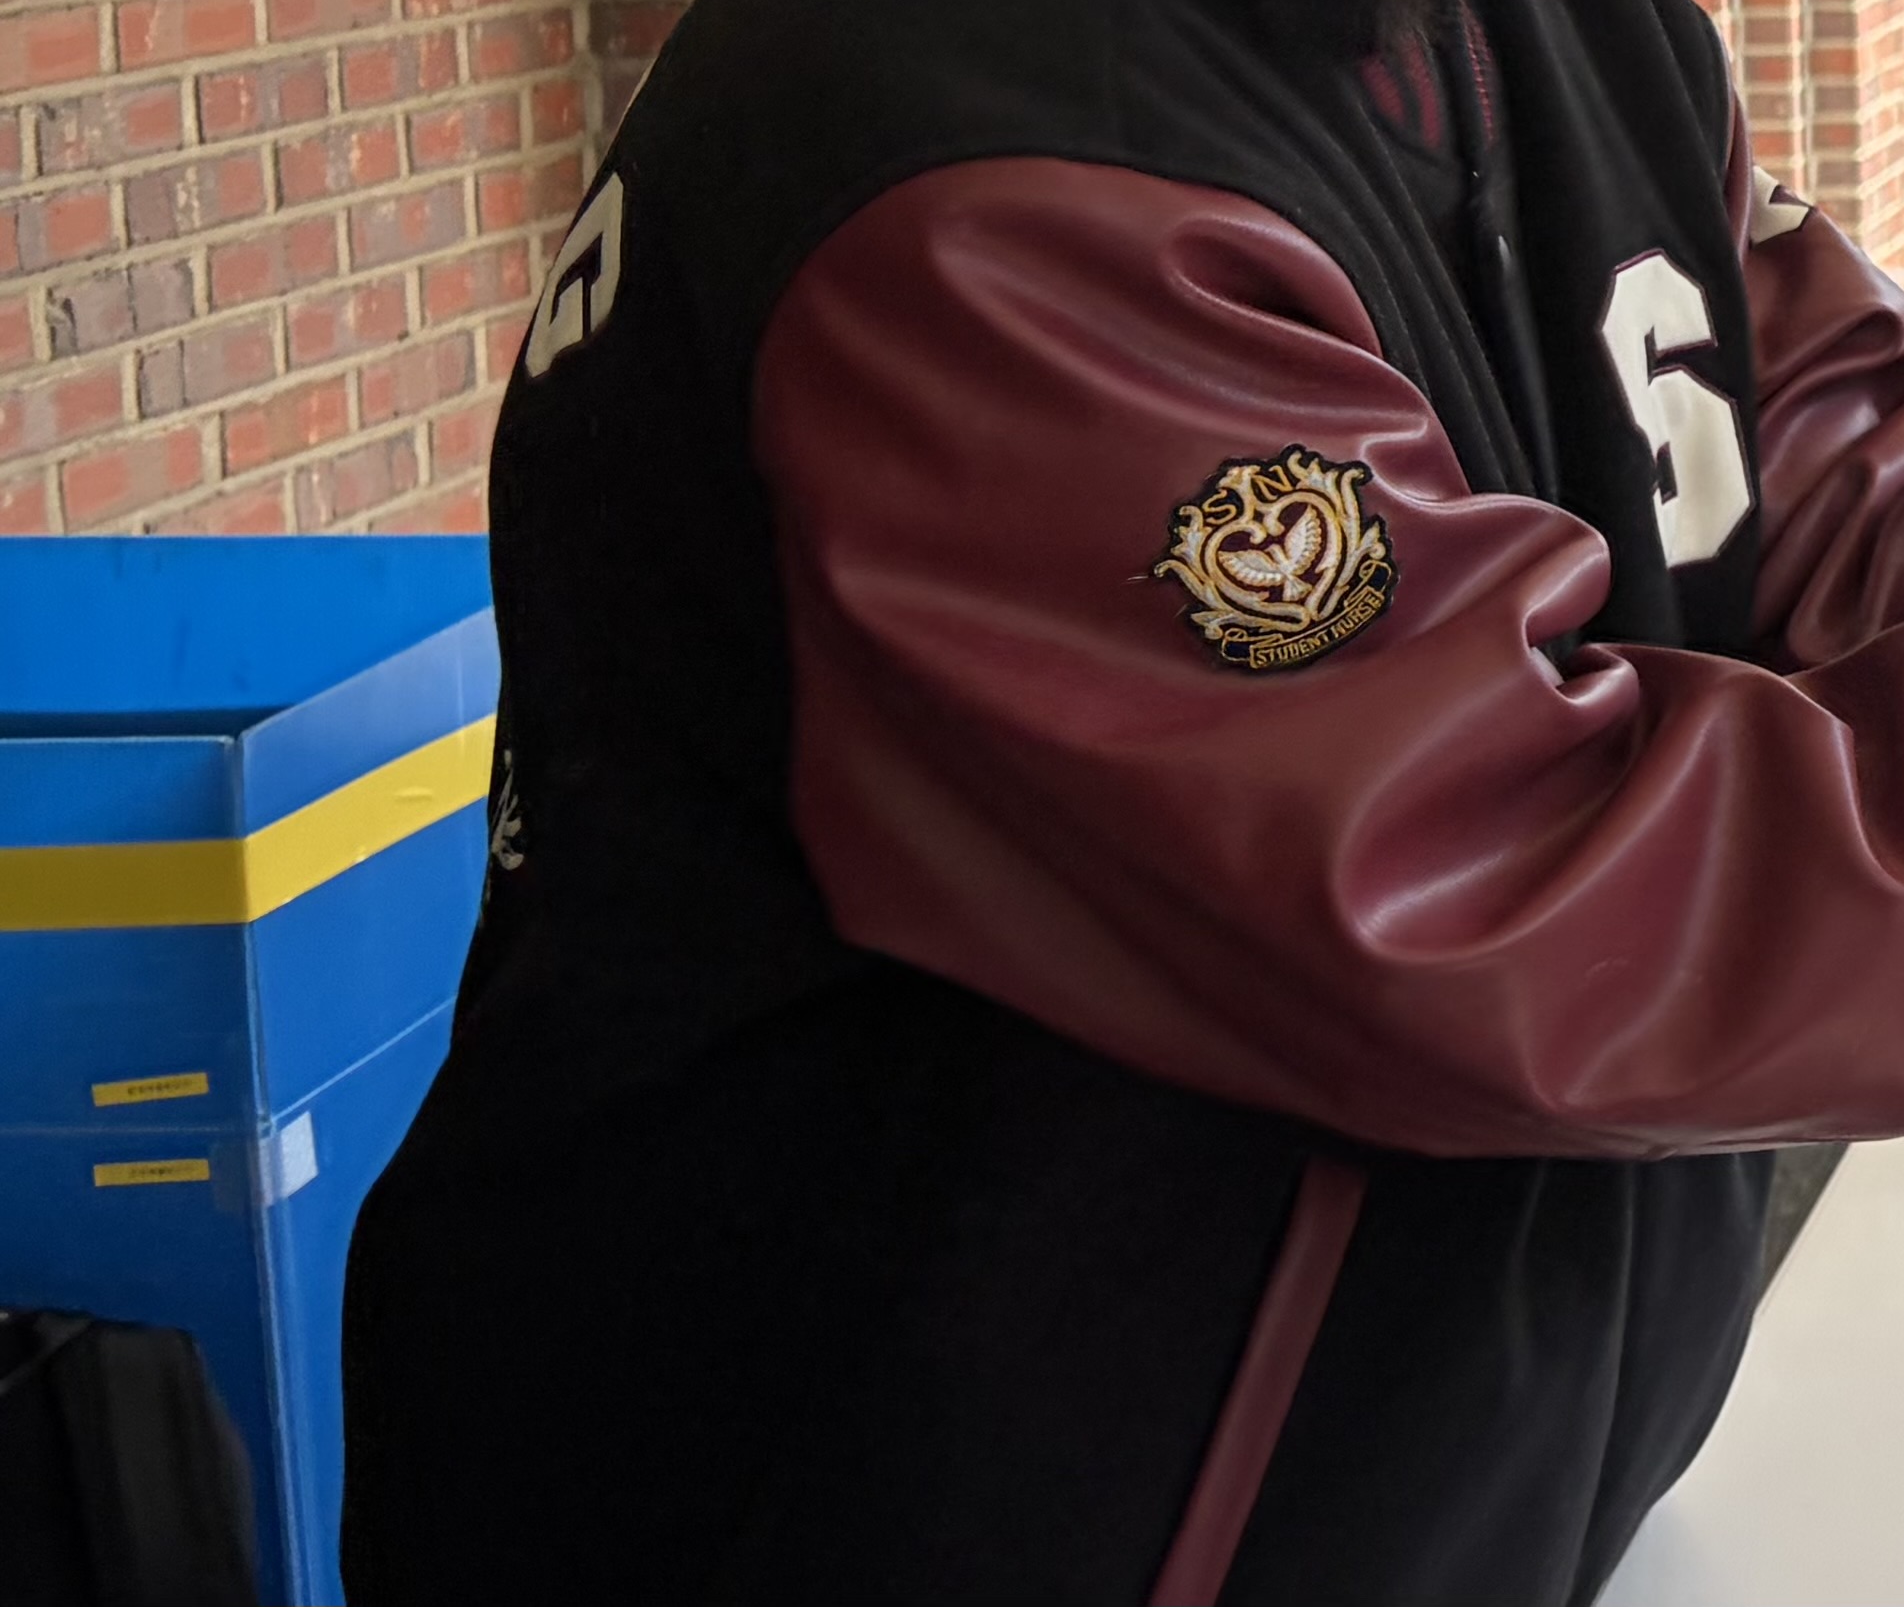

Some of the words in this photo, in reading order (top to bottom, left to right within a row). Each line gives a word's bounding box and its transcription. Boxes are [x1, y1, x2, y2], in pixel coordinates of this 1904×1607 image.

[1603, 248, 1756, 569] S
[1256, 630, 1330, 665] STUDENT
[1330, 593, 1380, 639] NURSE
